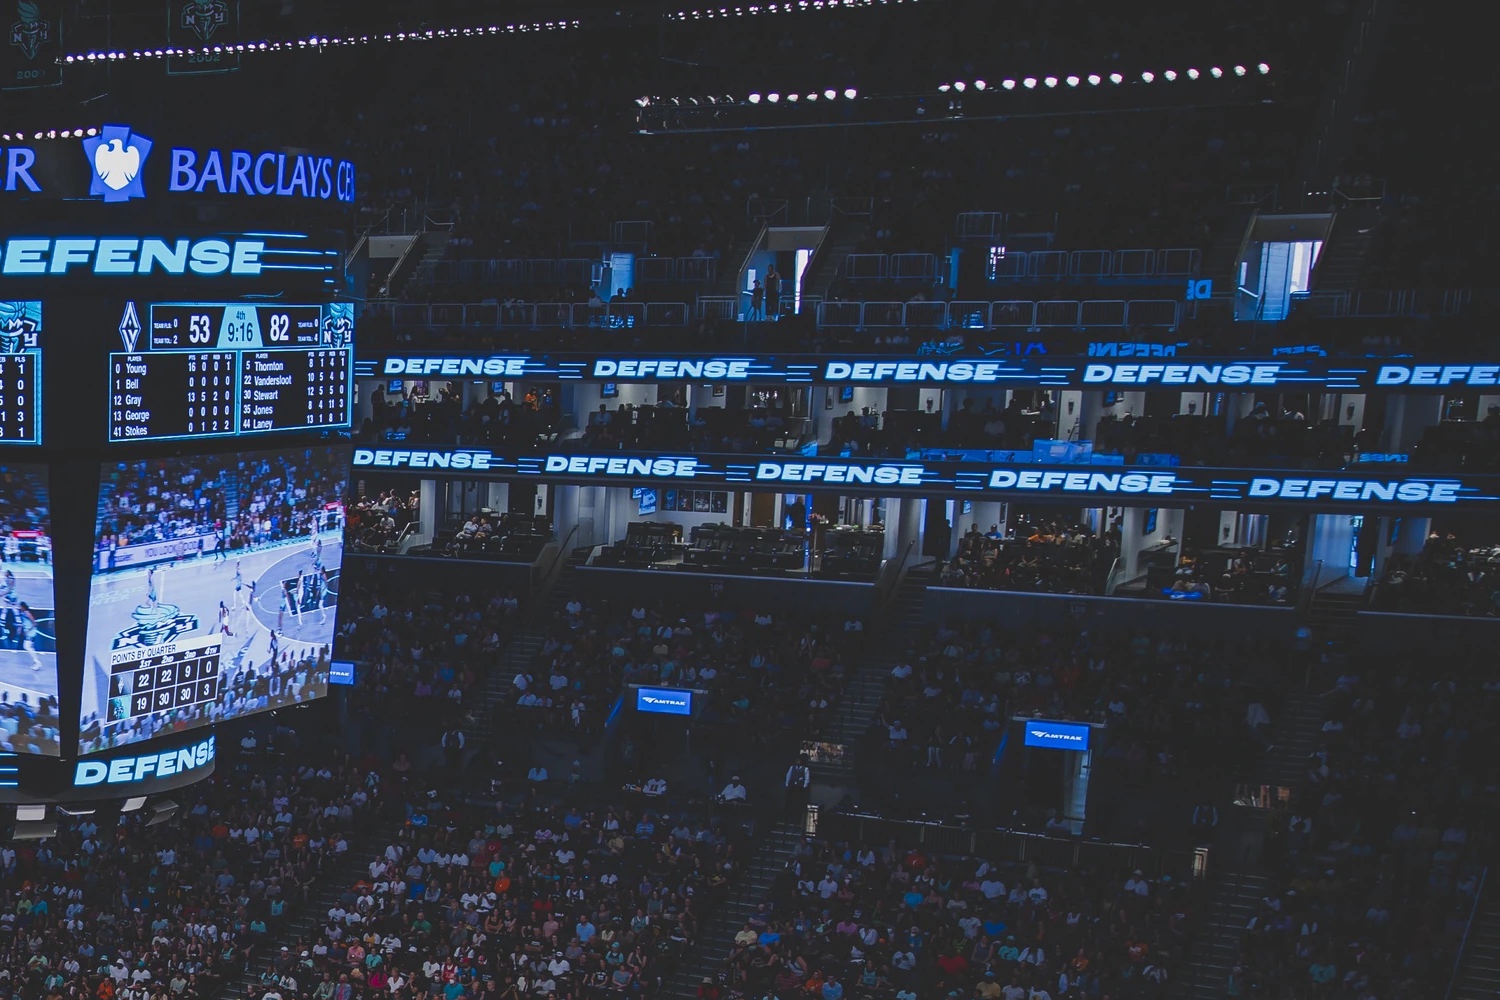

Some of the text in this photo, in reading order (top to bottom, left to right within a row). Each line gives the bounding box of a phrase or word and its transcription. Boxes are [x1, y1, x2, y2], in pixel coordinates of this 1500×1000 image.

[169, 149, 332, 199] BARCLAYS
[236, 311, 246, 320] 4th
[189, 315, 210, 343] 53
[228, 322, 253, 342] 9:16
[270, 315, 289, 341] 82
[126, 363, 147, 376] Young
[254, 361, 284, 372] Thornton
[384, 358, 526, 377] DEFENSE
[594, 360, 752, 378] DEFENSE
[825, 361, 999, 381] DEFENSE
[1083, 364, 1279, 384] DEFENSE
[126, 379, 139, 389] Bell
[254, 375, 292, 386] Vandersloot
[126, 395, 142, 407] Gray
[254, 390, 278, 401] Stewart
[125, 410, 150, 422] George
[253, 405, 273, 415] Jones
[125, 425, 148, 436] Stokes
[253, 419, 273, 430] Laney
[353, 450, 491, 469] DEFENSE
[546, 456, 697, 477] DEFENSE
[756, 463, 925, 484] DEFENSE
[988, 471, 1177, 493] DEFENSE
[1249, 478, 1461, 501] DEFENSE
[112, 644, 176, 663] POINTS BY QUARTER
[139, 661, 212, 687] 22 22 9 0
[137, 683, 210, 711] 19 30 30 3
[1044, 733, 1083, 741] AMTRAK
[74, 735, 216, 786] DEFENSE
